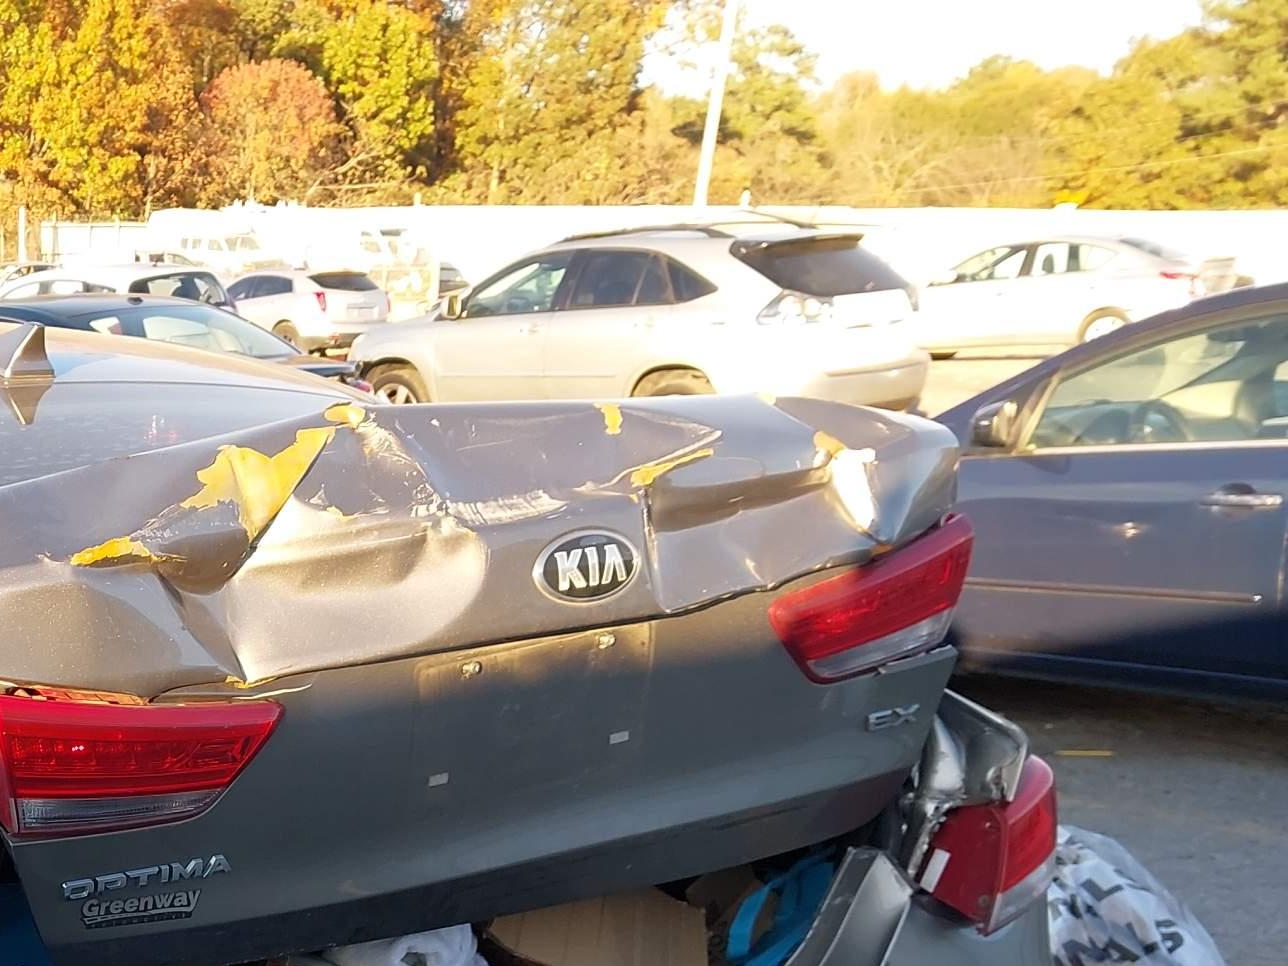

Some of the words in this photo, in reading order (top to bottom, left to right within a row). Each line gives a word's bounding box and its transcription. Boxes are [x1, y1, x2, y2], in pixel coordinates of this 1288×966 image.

[554, 543, 627, 591] KIA
[868, 703, 920, 730] EX
[61, 854, 232, 899] OPTIMA
[82, 889, 201, 918] Greenway
